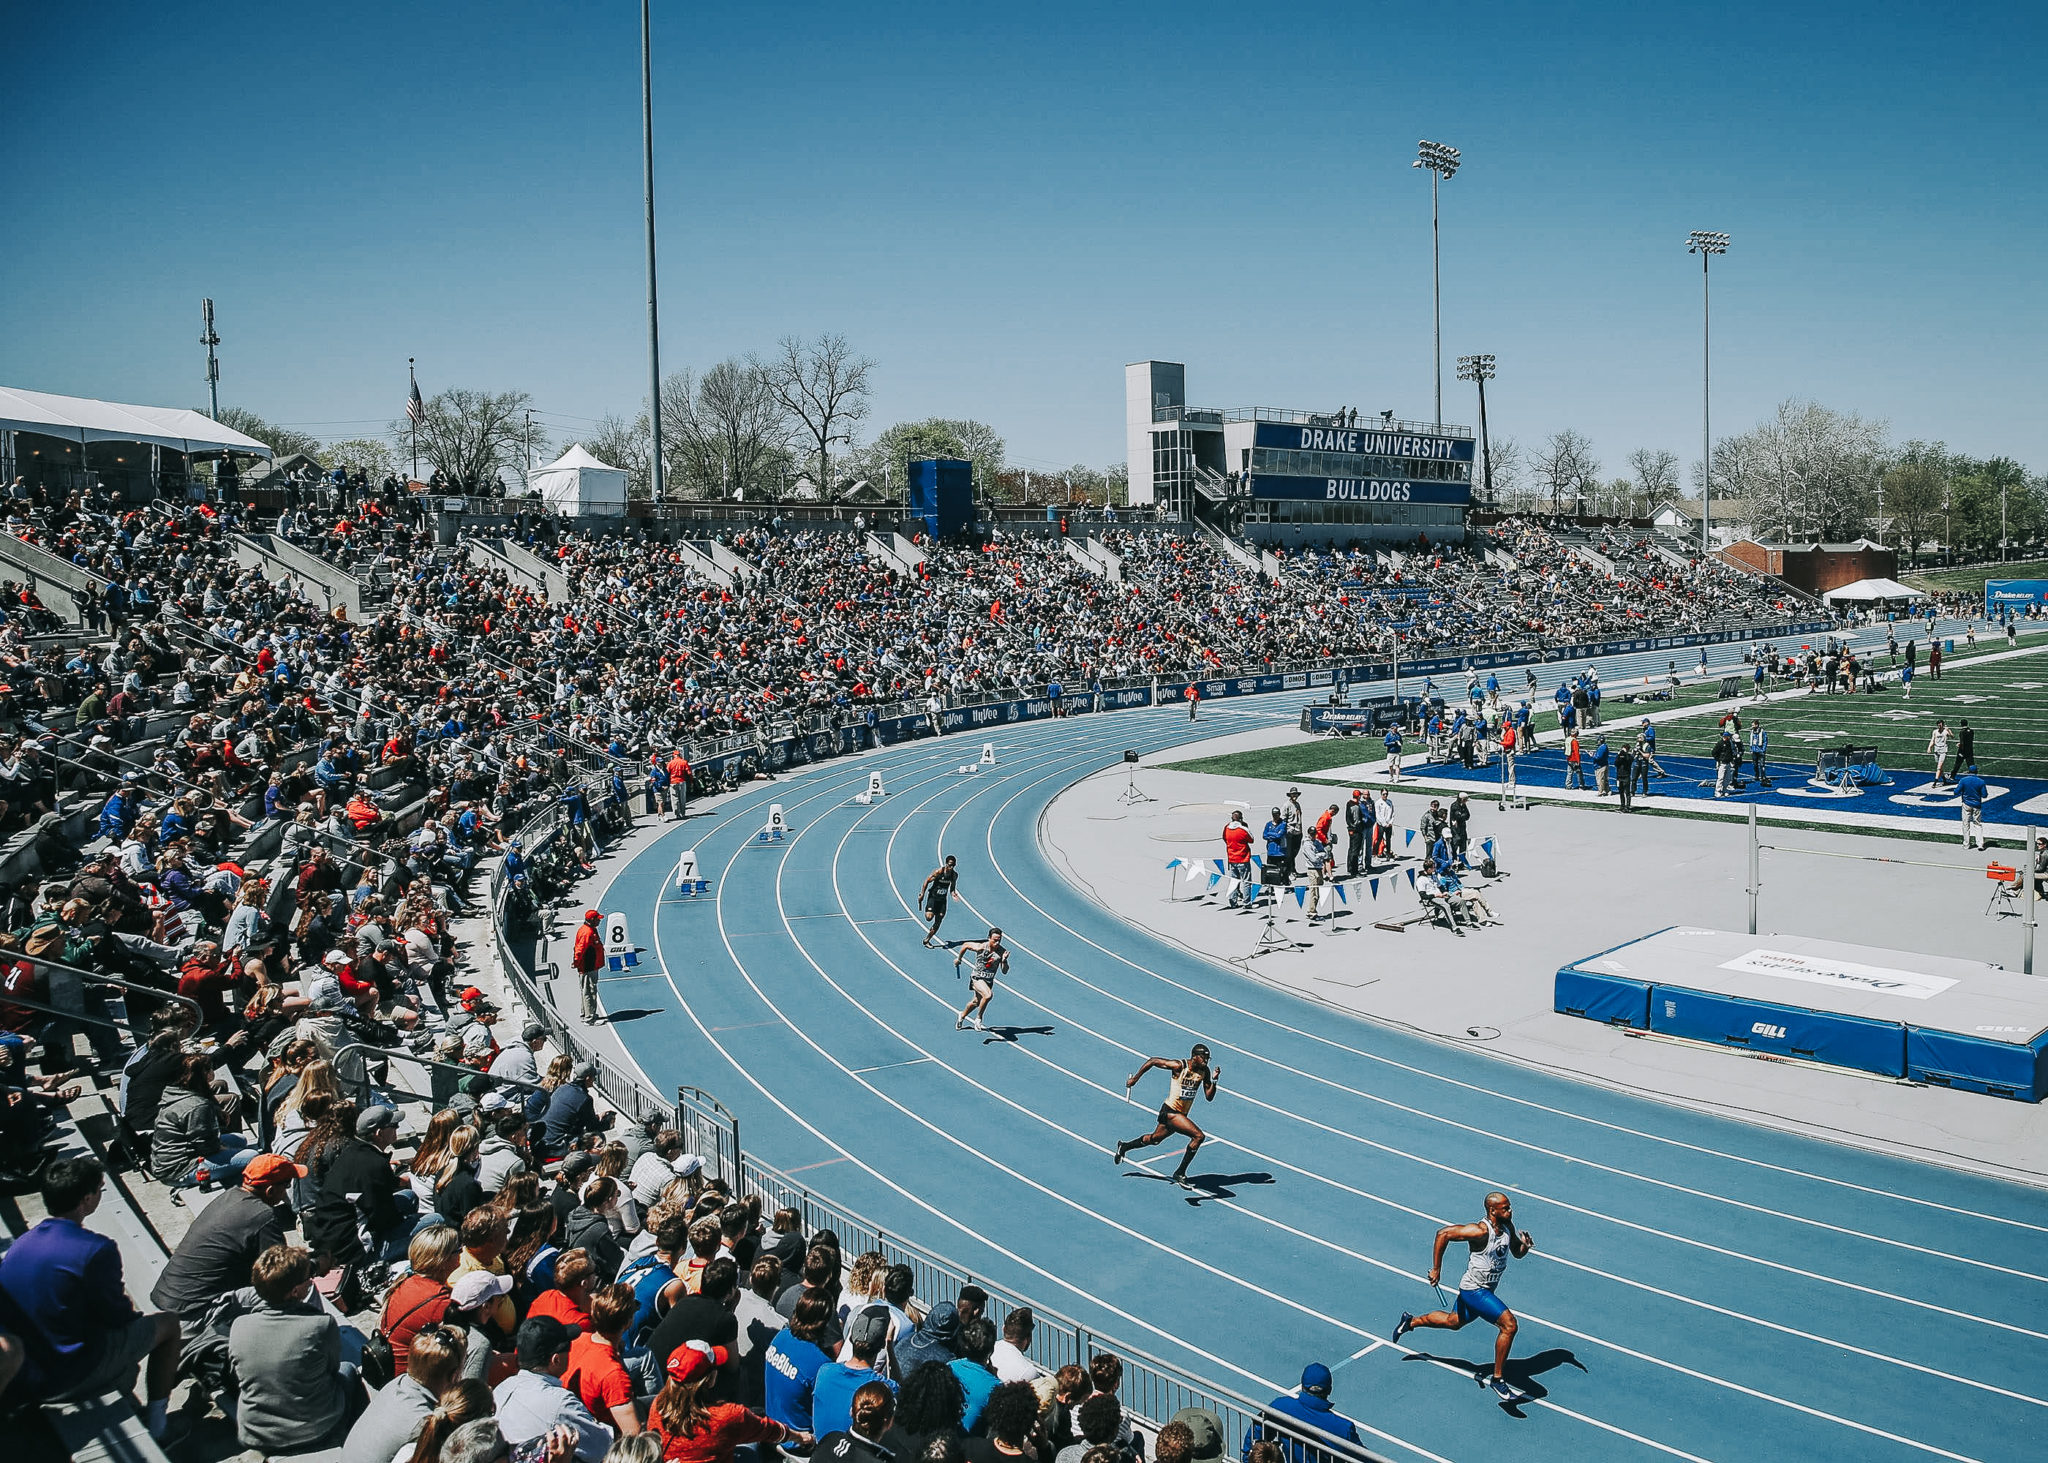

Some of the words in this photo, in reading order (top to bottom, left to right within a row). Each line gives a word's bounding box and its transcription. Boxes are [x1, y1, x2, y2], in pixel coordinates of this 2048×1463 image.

[1300, 428, 1358, 452] DRAKE
[1364, 433, 1454, 459] UNIVERSITY
[1326, 479, 1411, 501] BULLDOGS
[1206, 682, 1226, 692] Smart
[1237, 679, 1257, 689] Smart
[1157, 688, 1177, 702] yVee
[943, 712, 963, 729] yVee
[1321, 710, 1345, 720] Drake
[984, 749, 991, 758] 4
[872, 778, 880, 790] 5
[772, 812, 781, 825] 6
[683, 862, 694, 876] 7
[611, 925, 625, 943] 8
[4, 966, 22, 991] 21
[1751, 1021, 1787, 1039] GILL
[1975, 1025, 2030, 1033] GILL
